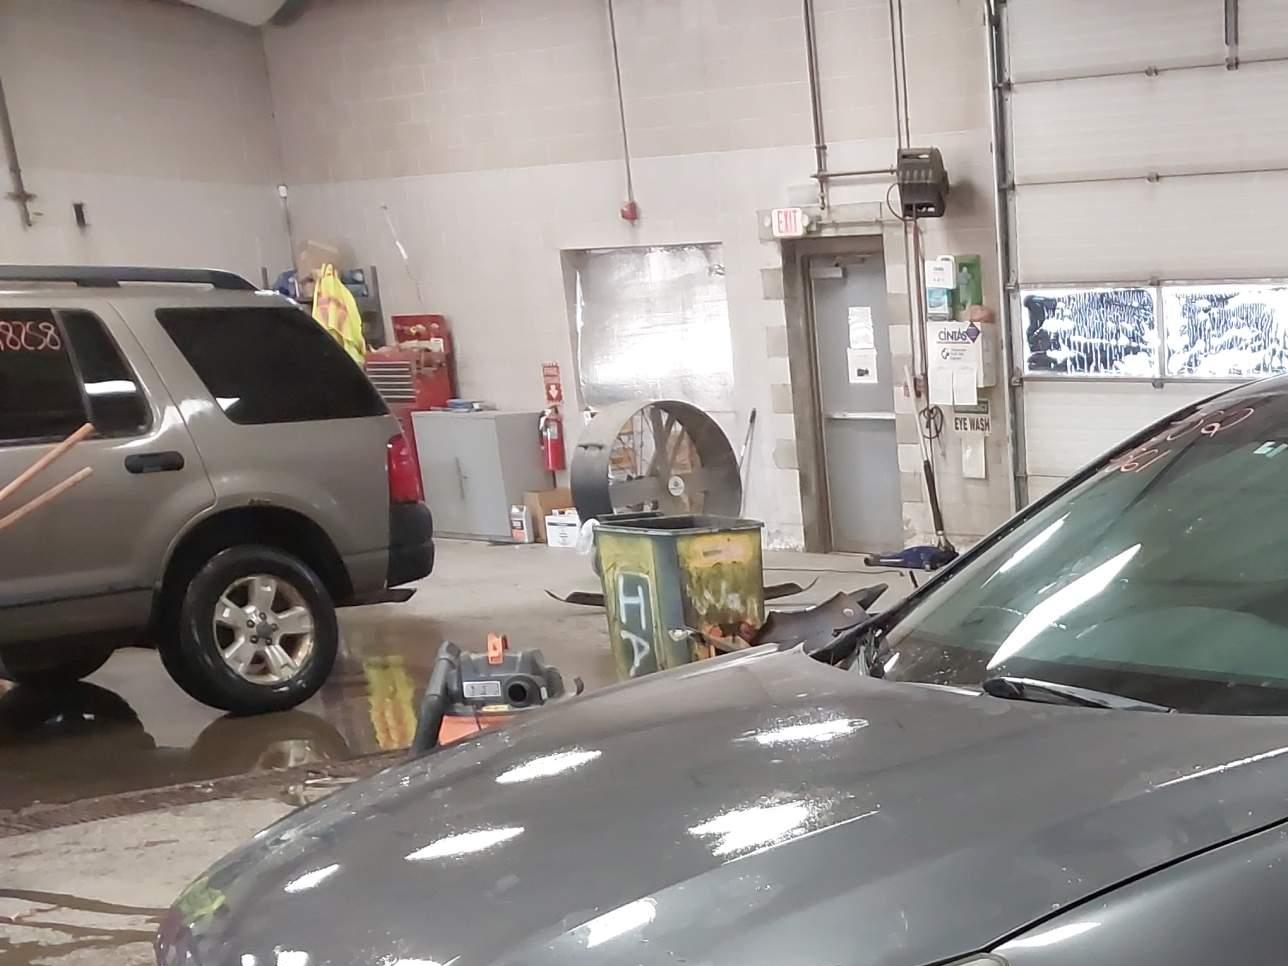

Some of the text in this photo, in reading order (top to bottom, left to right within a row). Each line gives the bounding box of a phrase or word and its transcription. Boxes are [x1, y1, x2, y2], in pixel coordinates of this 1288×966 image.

[777, 210, 799, 233] EXIT
[0, 321, 61, 351] 8258
[954, 417, 990, 432] EYE WASH
